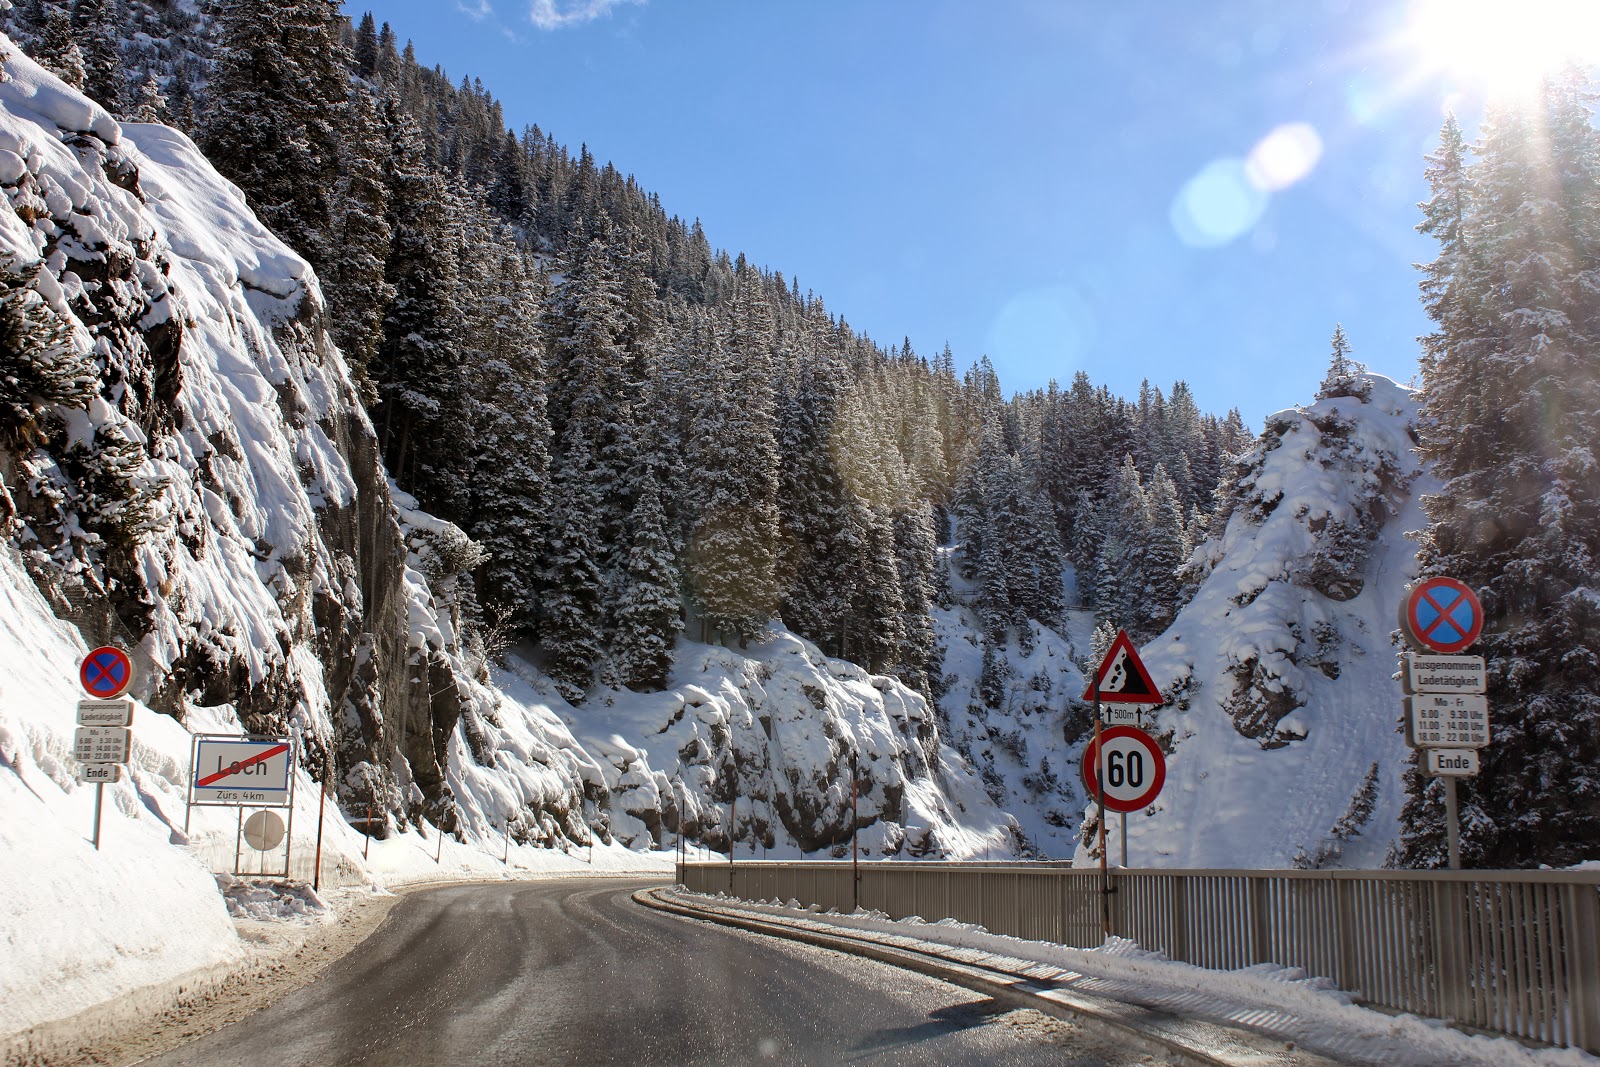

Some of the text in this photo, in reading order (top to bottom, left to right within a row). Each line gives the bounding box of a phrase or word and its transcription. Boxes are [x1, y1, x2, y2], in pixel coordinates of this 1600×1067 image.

[1414, 662, 1480, 671] ausgenommen
[1418, 675, 1478, 688] Ladetätigkeit
[1434, 698, 1448, 706] Mo
[1456, 698, 1464, 706] Fr
[1114, 709, 1134, 719] 500m
[1421, 710, 1438, 718] 6.00
[1450, 710, 1468, 719] 9.30
[1470, 711, 1483, 719] Uhr
[1419, 721, 1439, 729] 11.00
[1447, 722, 1468, 730] 14.00
[1471, 722, 1484, 730] Uhr
[1418, 732, 1440, 741] 18.00
[1471, 734, 1484, 742] Uhr
[1438, 755, 1469, 768] Ende
[86, 768, 108, 778] Ende
[1108, 750, 1143, 787] 60
[216, 790, 238, 800] Zürs
